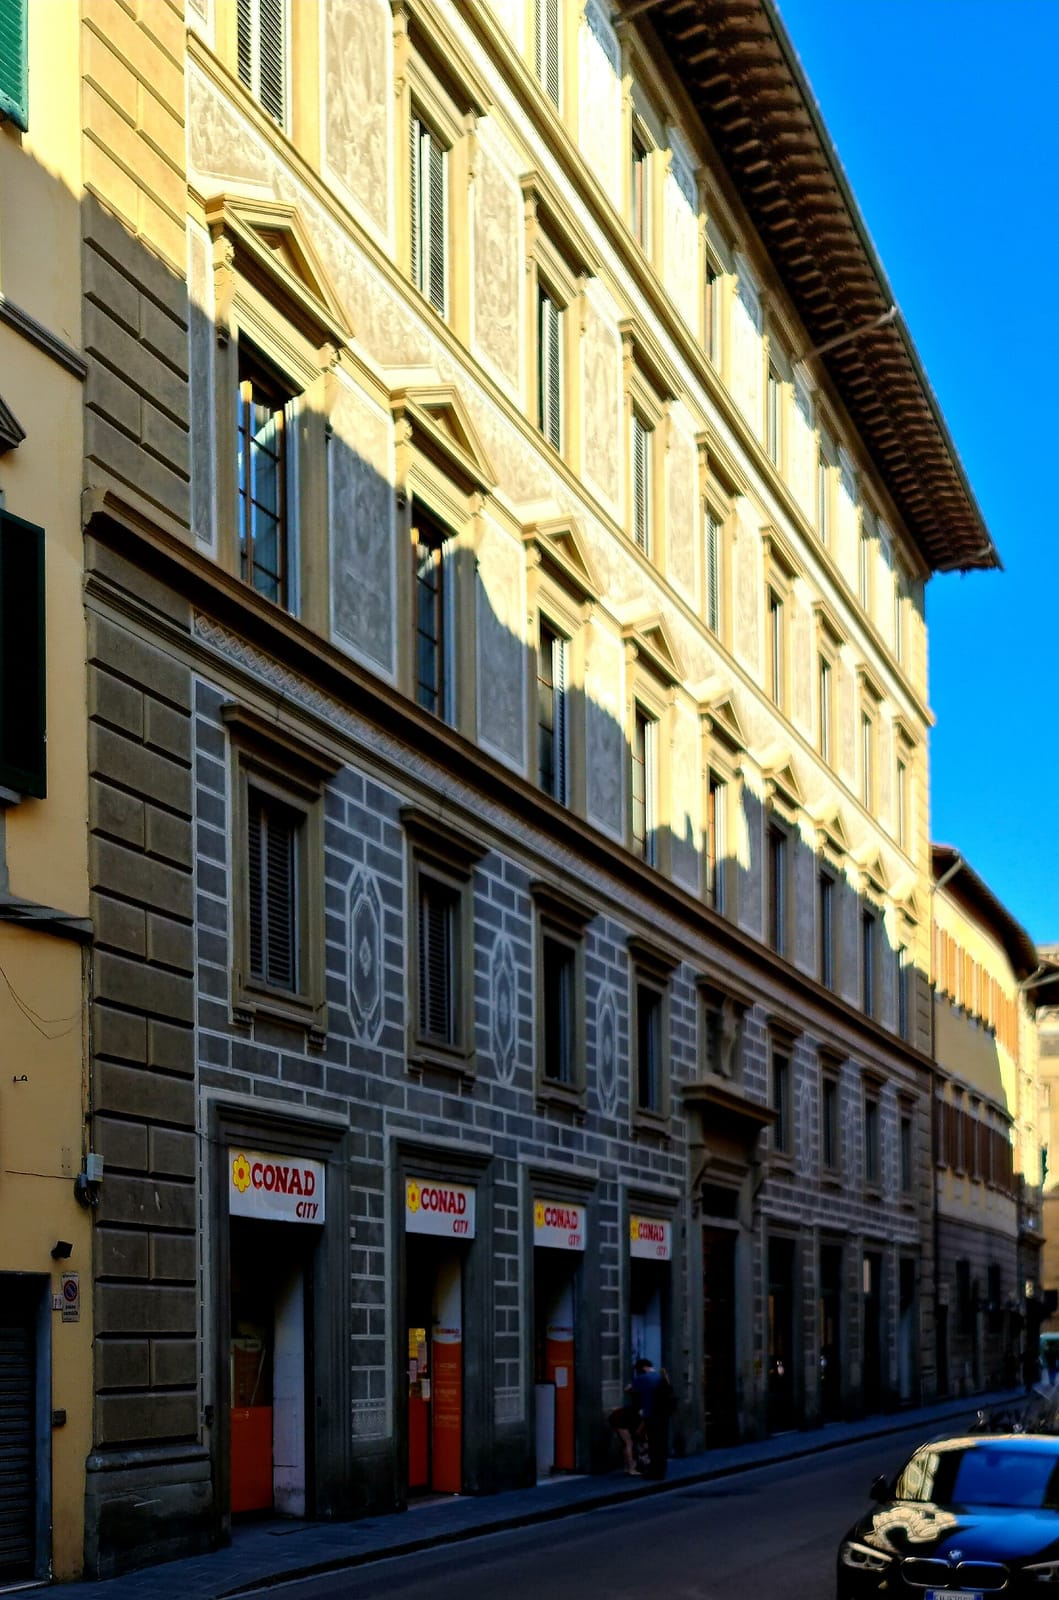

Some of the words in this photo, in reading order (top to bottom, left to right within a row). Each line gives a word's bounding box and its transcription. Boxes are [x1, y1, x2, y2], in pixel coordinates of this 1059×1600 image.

[252, 1163, 315, 1196] CONAD
[296, 1202, 318, 1219] CITY
[421, 1188, 466, 1215] CONAD
[453, 1219, 468, 1234] CITY
[544, 1207, 578, 1230] CONAD
[638, 1222, 664, 1242] CONAD
